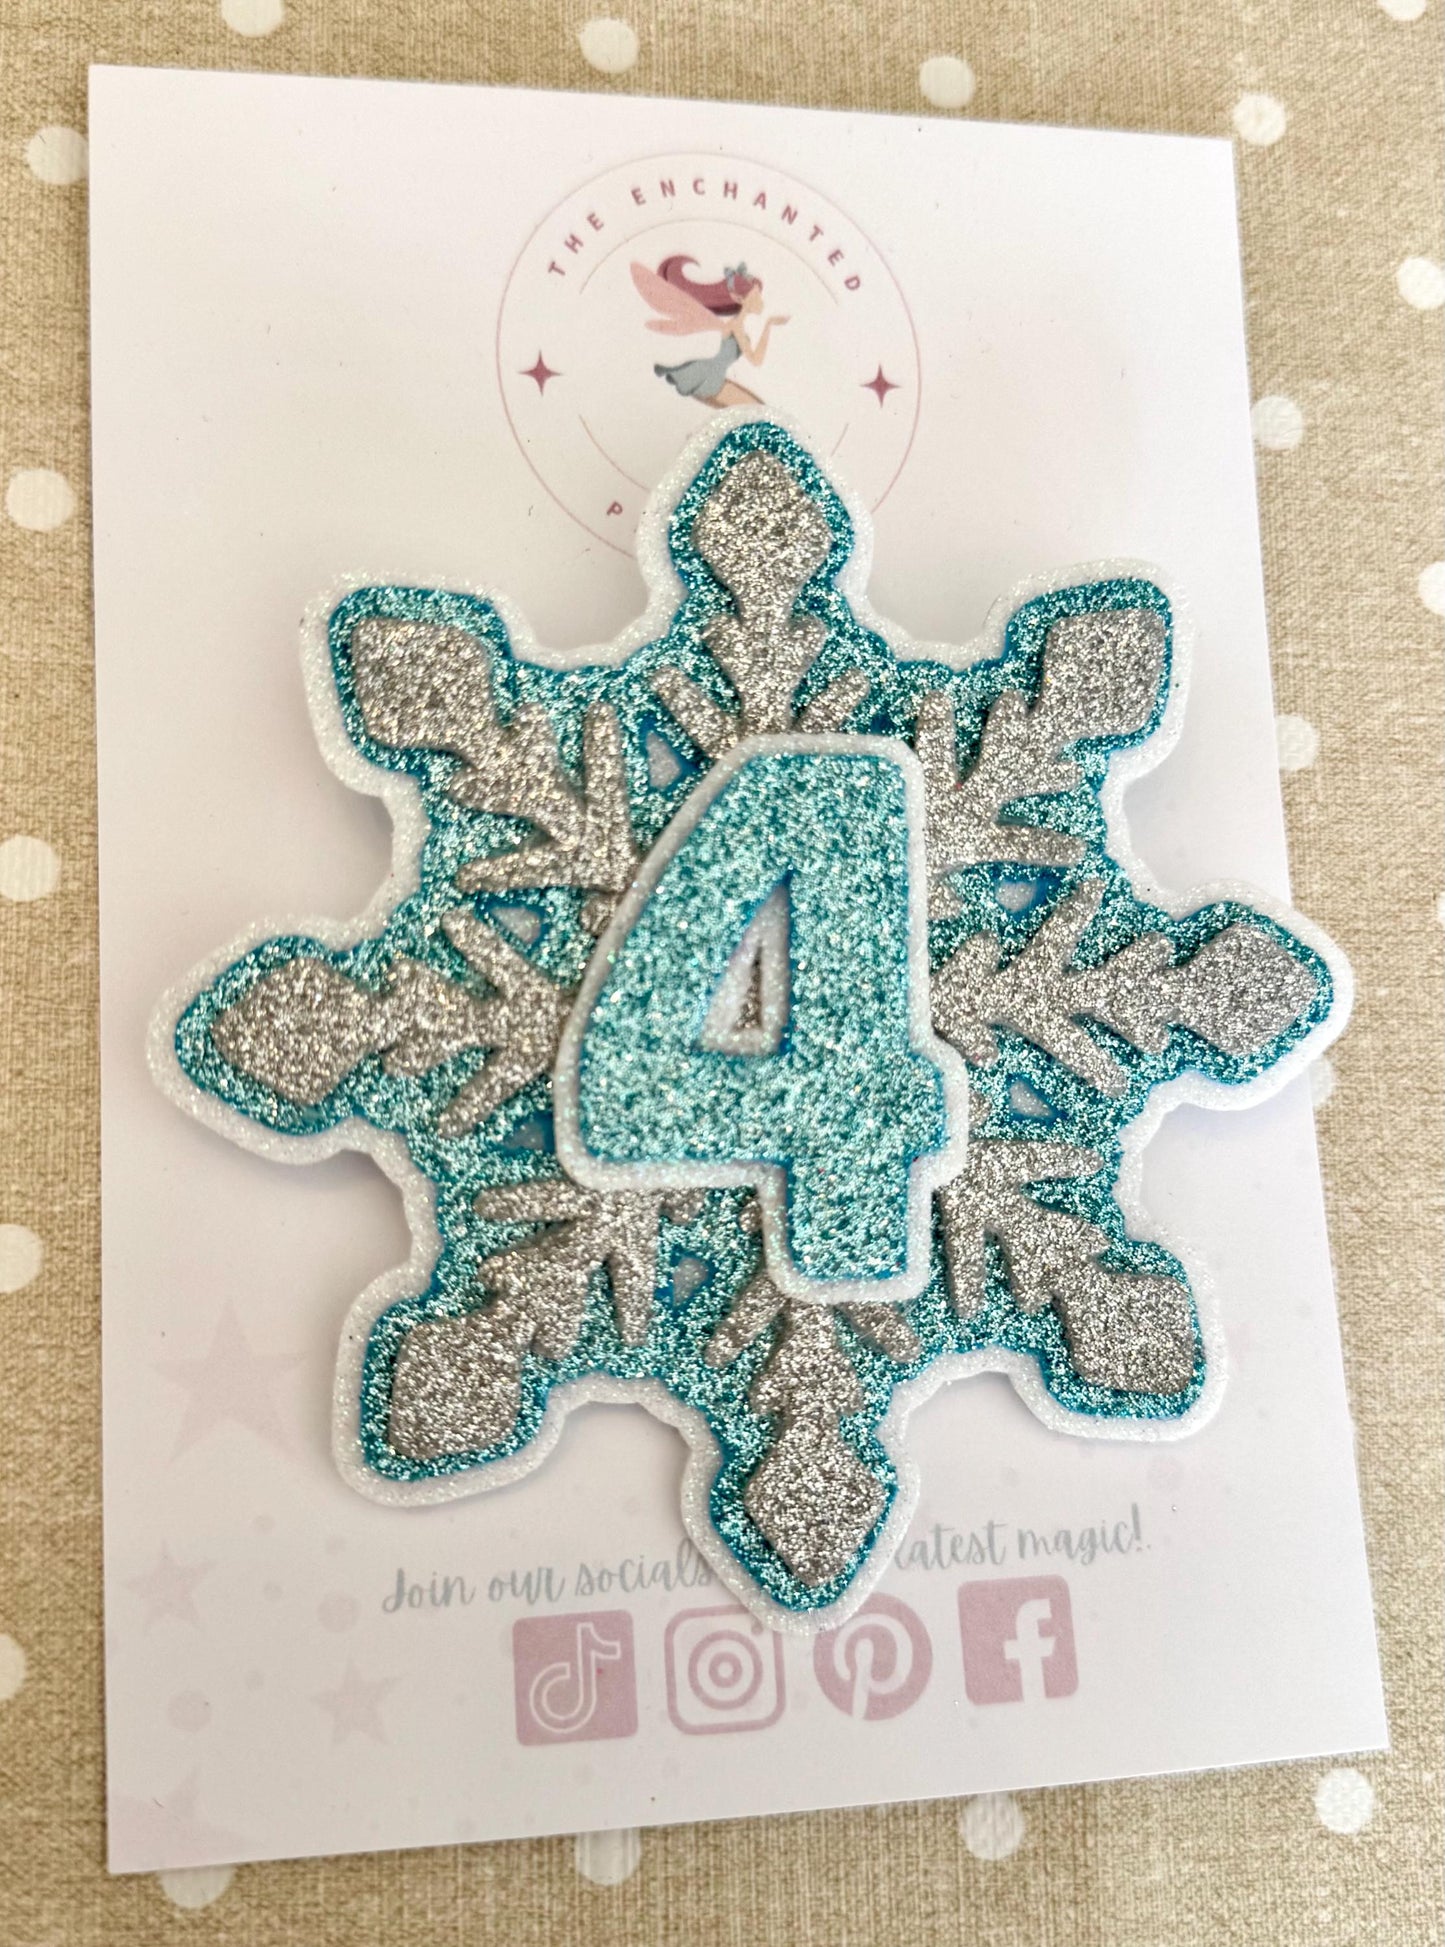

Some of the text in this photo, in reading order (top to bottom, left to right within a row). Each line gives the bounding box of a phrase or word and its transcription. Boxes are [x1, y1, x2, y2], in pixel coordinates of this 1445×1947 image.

[549, 178, 861, 292] THE ENCHANTED
[558, 737, 965, 1298] 4
[382, 1567, 476, 1614] Join
[487, 1566, 566, 1606] our
